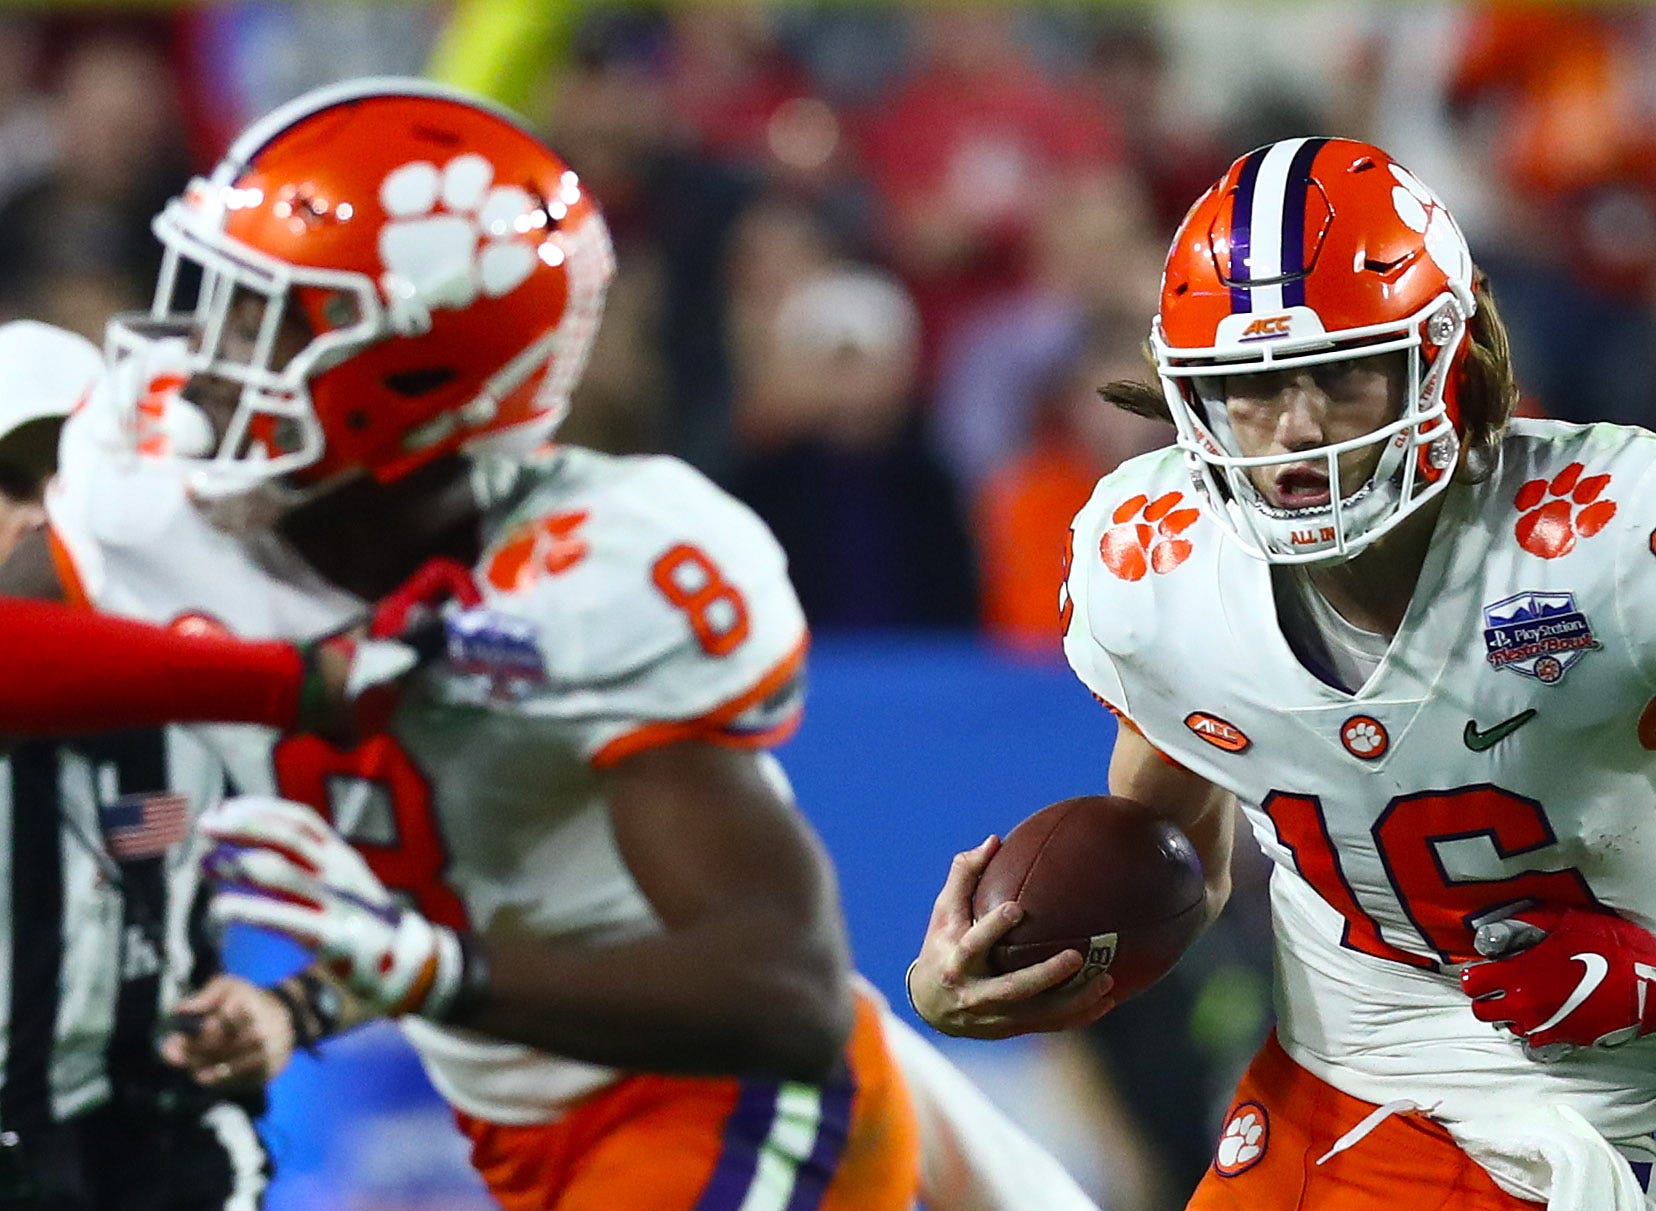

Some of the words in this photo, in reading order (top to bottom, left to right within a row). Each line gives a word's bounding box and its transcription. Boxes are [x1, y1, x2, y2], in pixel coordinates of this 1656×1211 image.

[1242, 315, 1292, 335] ACC
[1291, 530, 1318, 545] ALL
[1319, 526, 1335, 542] IN
[652, 543, 749, 659] 8
[1514, 620, 1584, 642] PlayStation
[1488, 641, 1542, 667] Fiesta
[1193, 719, 1239, 741] ACC
[1261, 782, 1600, 974] 16
